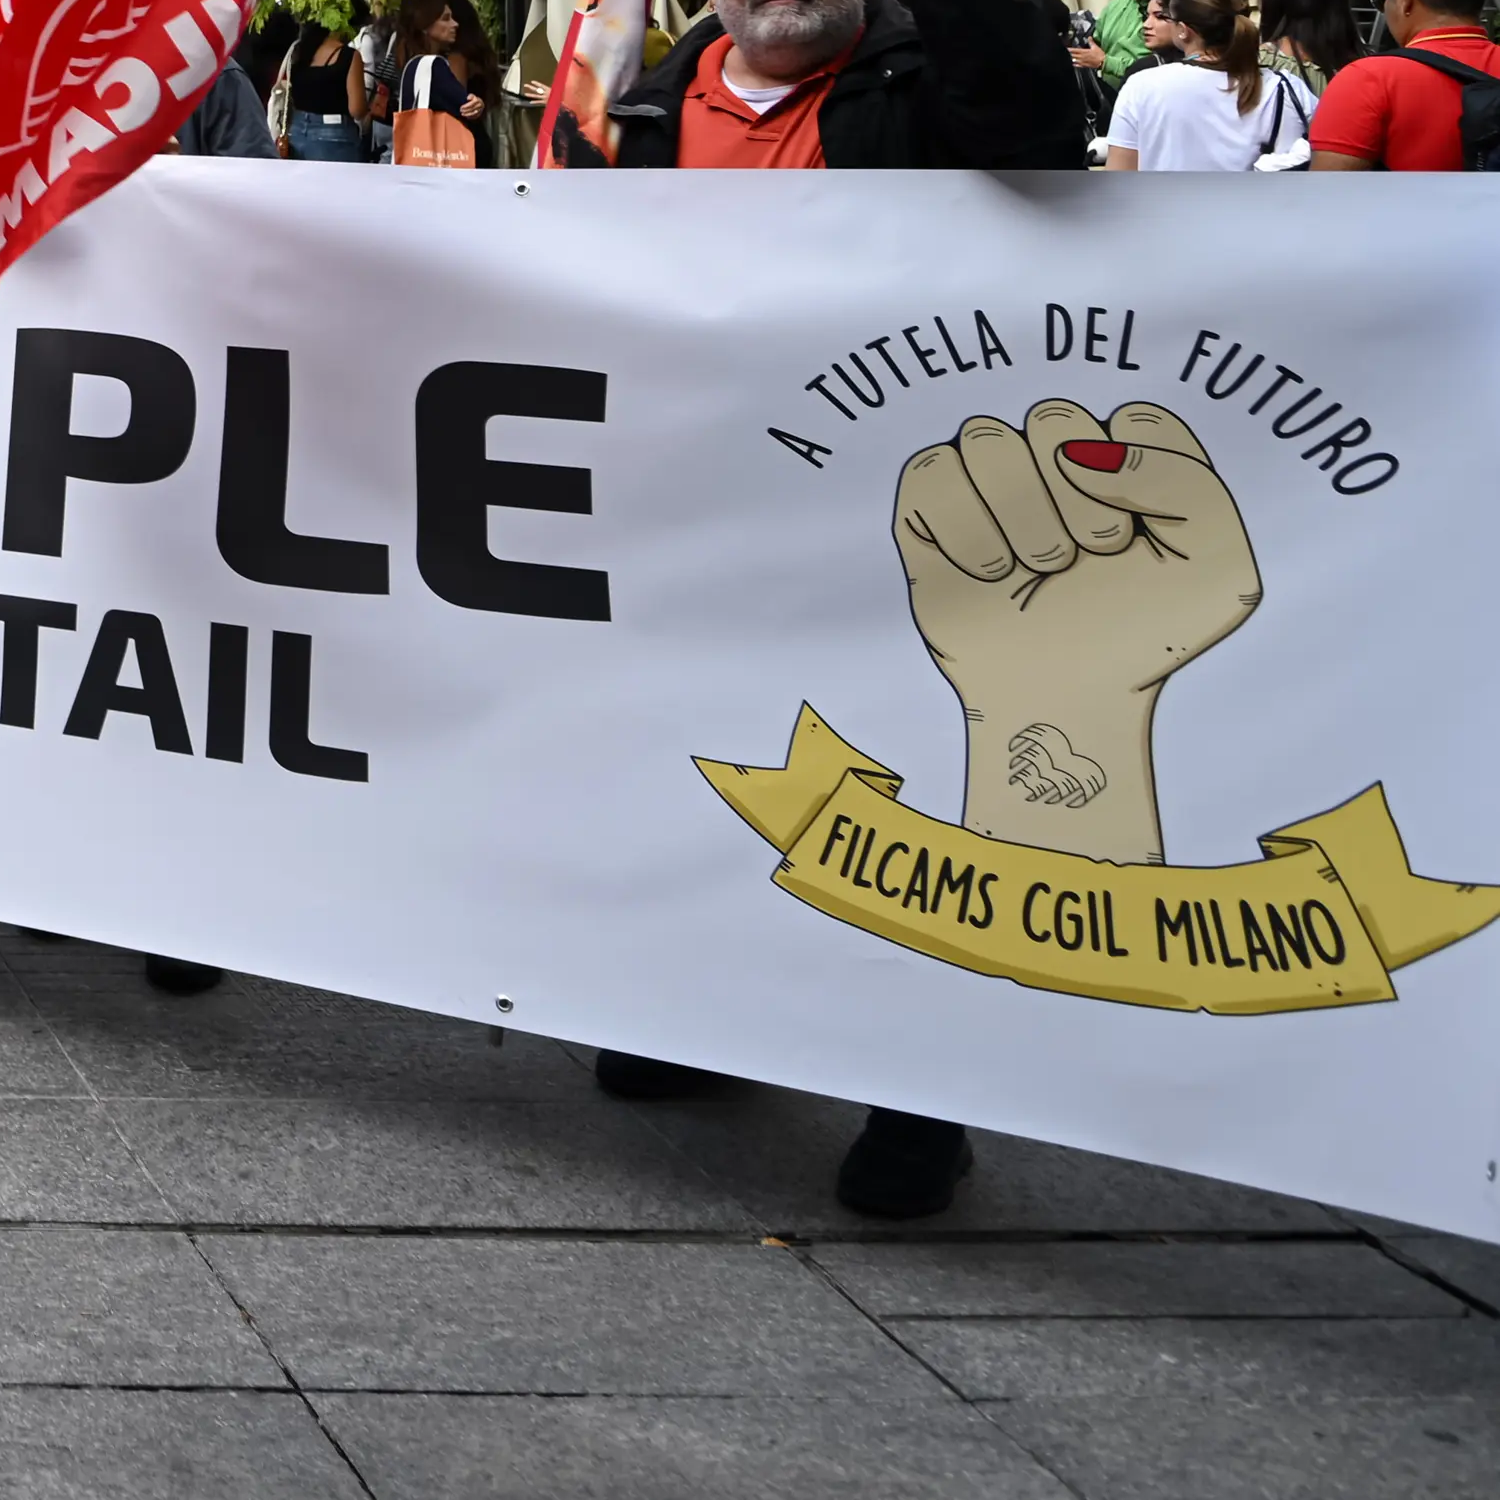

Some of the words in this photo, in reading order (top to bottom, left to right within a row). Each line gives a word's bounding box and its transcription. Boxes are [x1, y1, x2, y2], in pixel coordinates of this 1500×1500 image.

[767, 427, 833, 469] A
[805, 309, 1013, 421] TUTELA
[1044, 302, 1141, 372] DEL
[1179, 330, 1400, 497] FUTURO
[818, 814, 999, 930] FILCAMS
[1022, 881, 1128, 958] CGIL
[1156, 896, 1347, 973] MILANO
